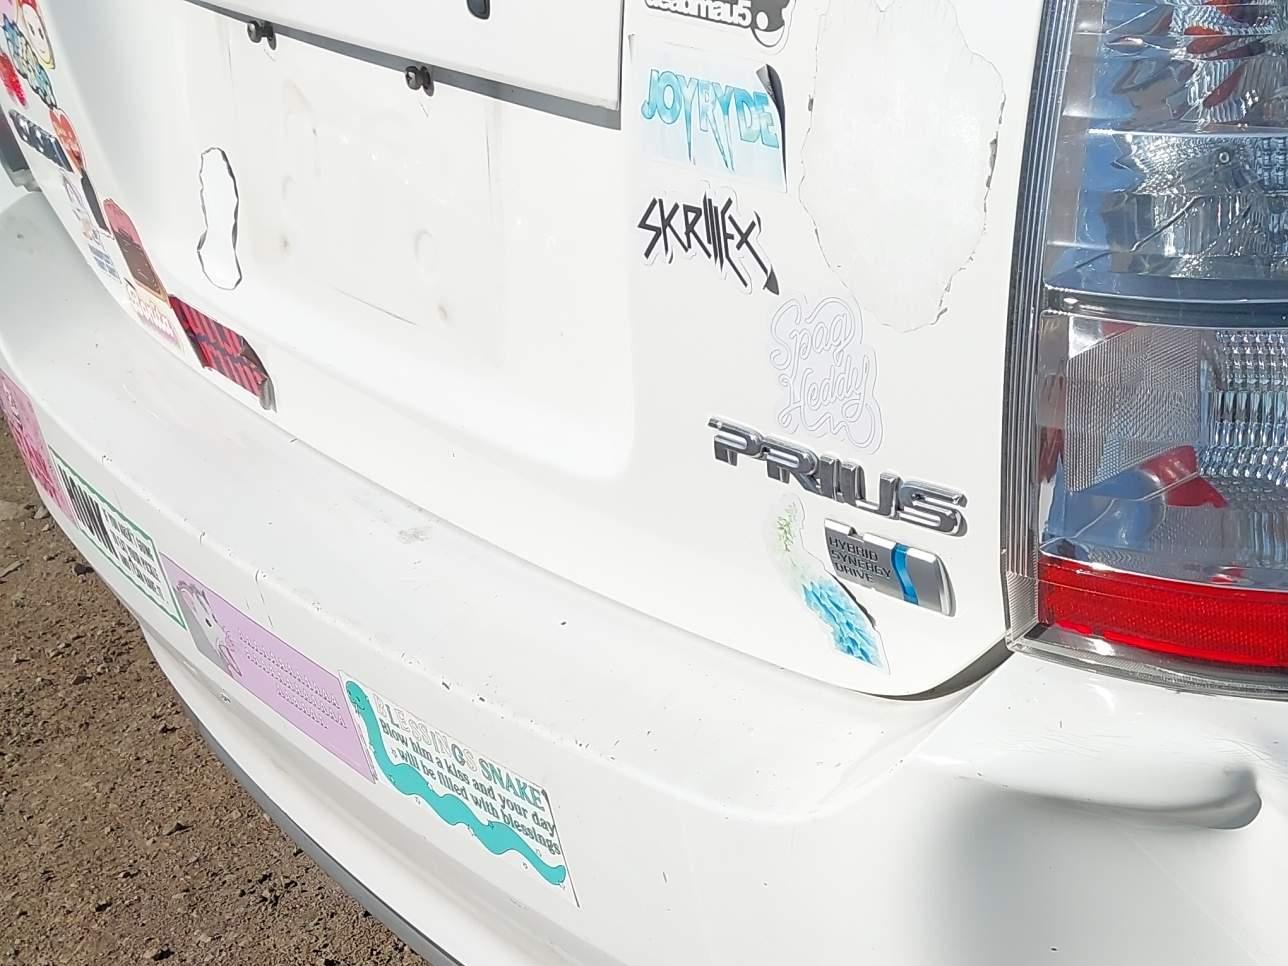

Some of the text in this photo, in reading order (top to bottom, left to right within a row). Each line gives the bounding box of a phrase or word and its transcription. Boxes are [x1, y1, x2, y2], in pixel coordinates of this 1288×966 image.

[641, 68, 780, 172] JOYRYDE
[708, 416, 968, 537] PRIUS
[829, 537, 878, 562] HYBRID
[831, 550, 891, 577] SYNERGY
[835, 562, 873, 582] DRIVE
[372, 694, 545, 812] BLESSINGS SNAKE
[379, 718, 556, 838] Blow him a kiss and your day
[398, 748, 561, 857] will be filled with blessings
